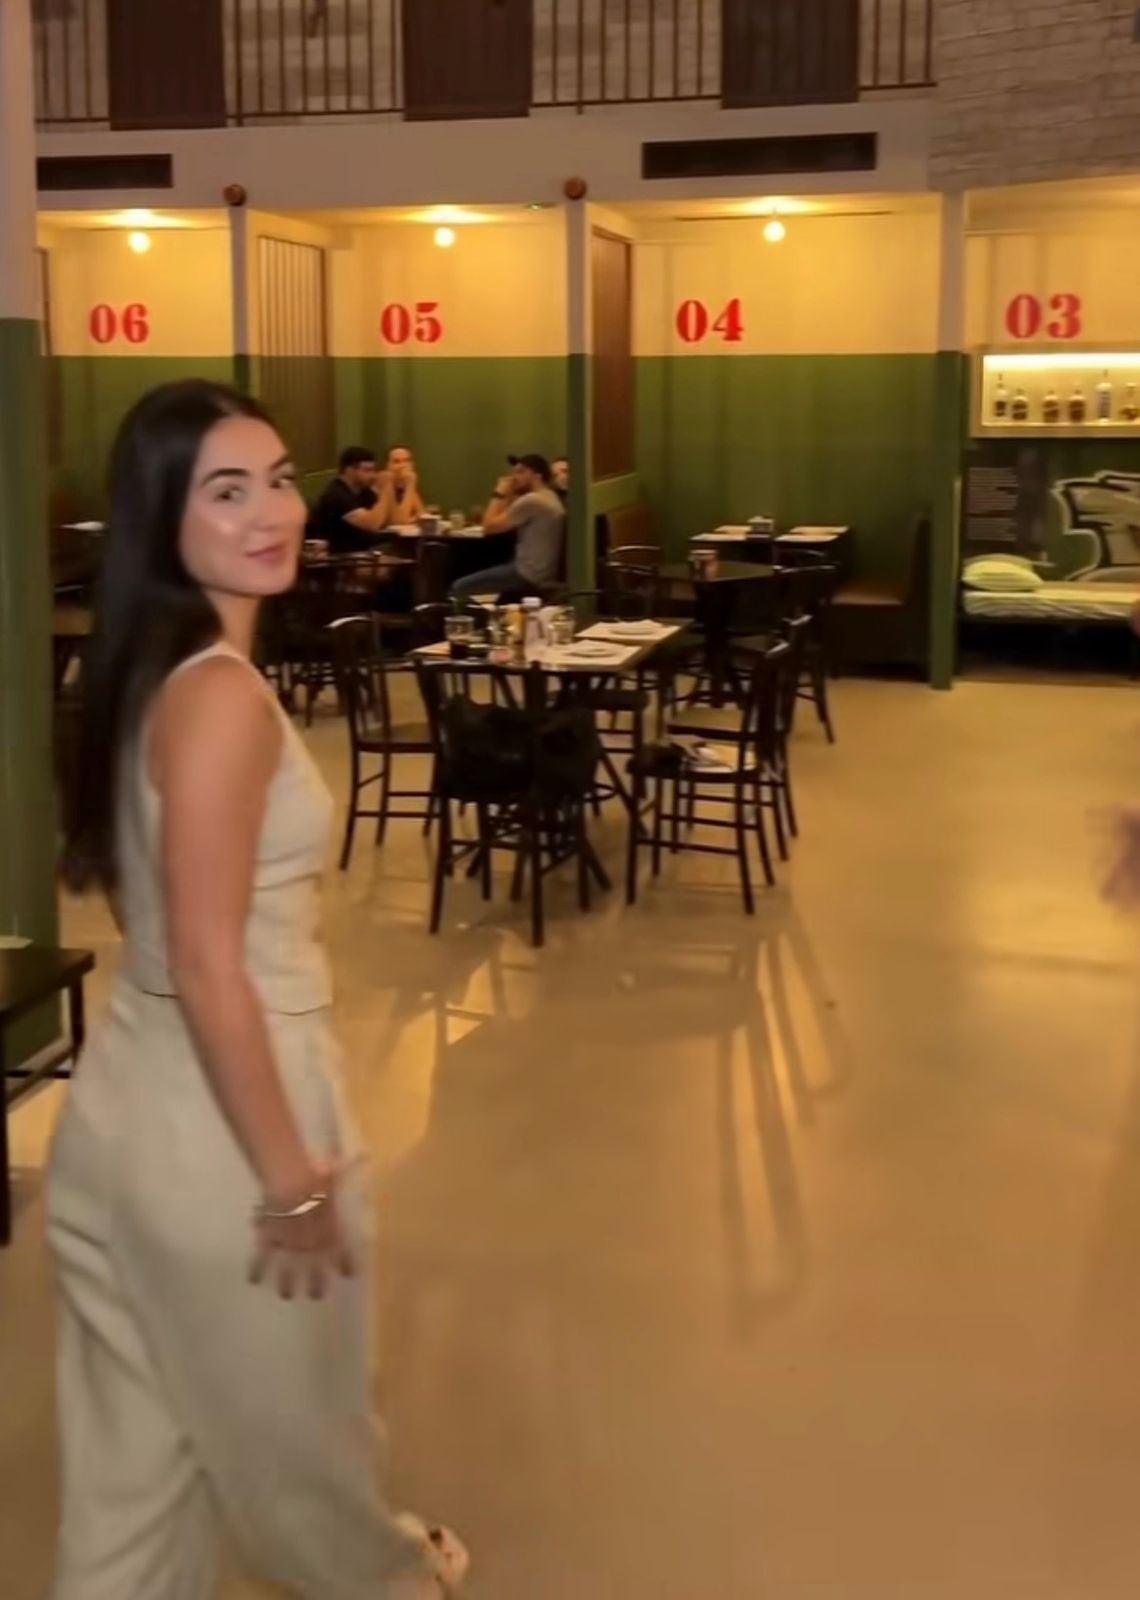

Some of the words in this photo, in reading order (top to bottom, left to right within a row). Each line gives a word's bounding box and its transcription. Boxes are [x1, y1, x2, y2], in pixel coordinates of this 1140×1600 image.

[89, 303, 149, 344] 06
[381, 302, 442, 345] 05
[676, 297, 744, 342] 04
[1005, 293, 1082, 339] 03
